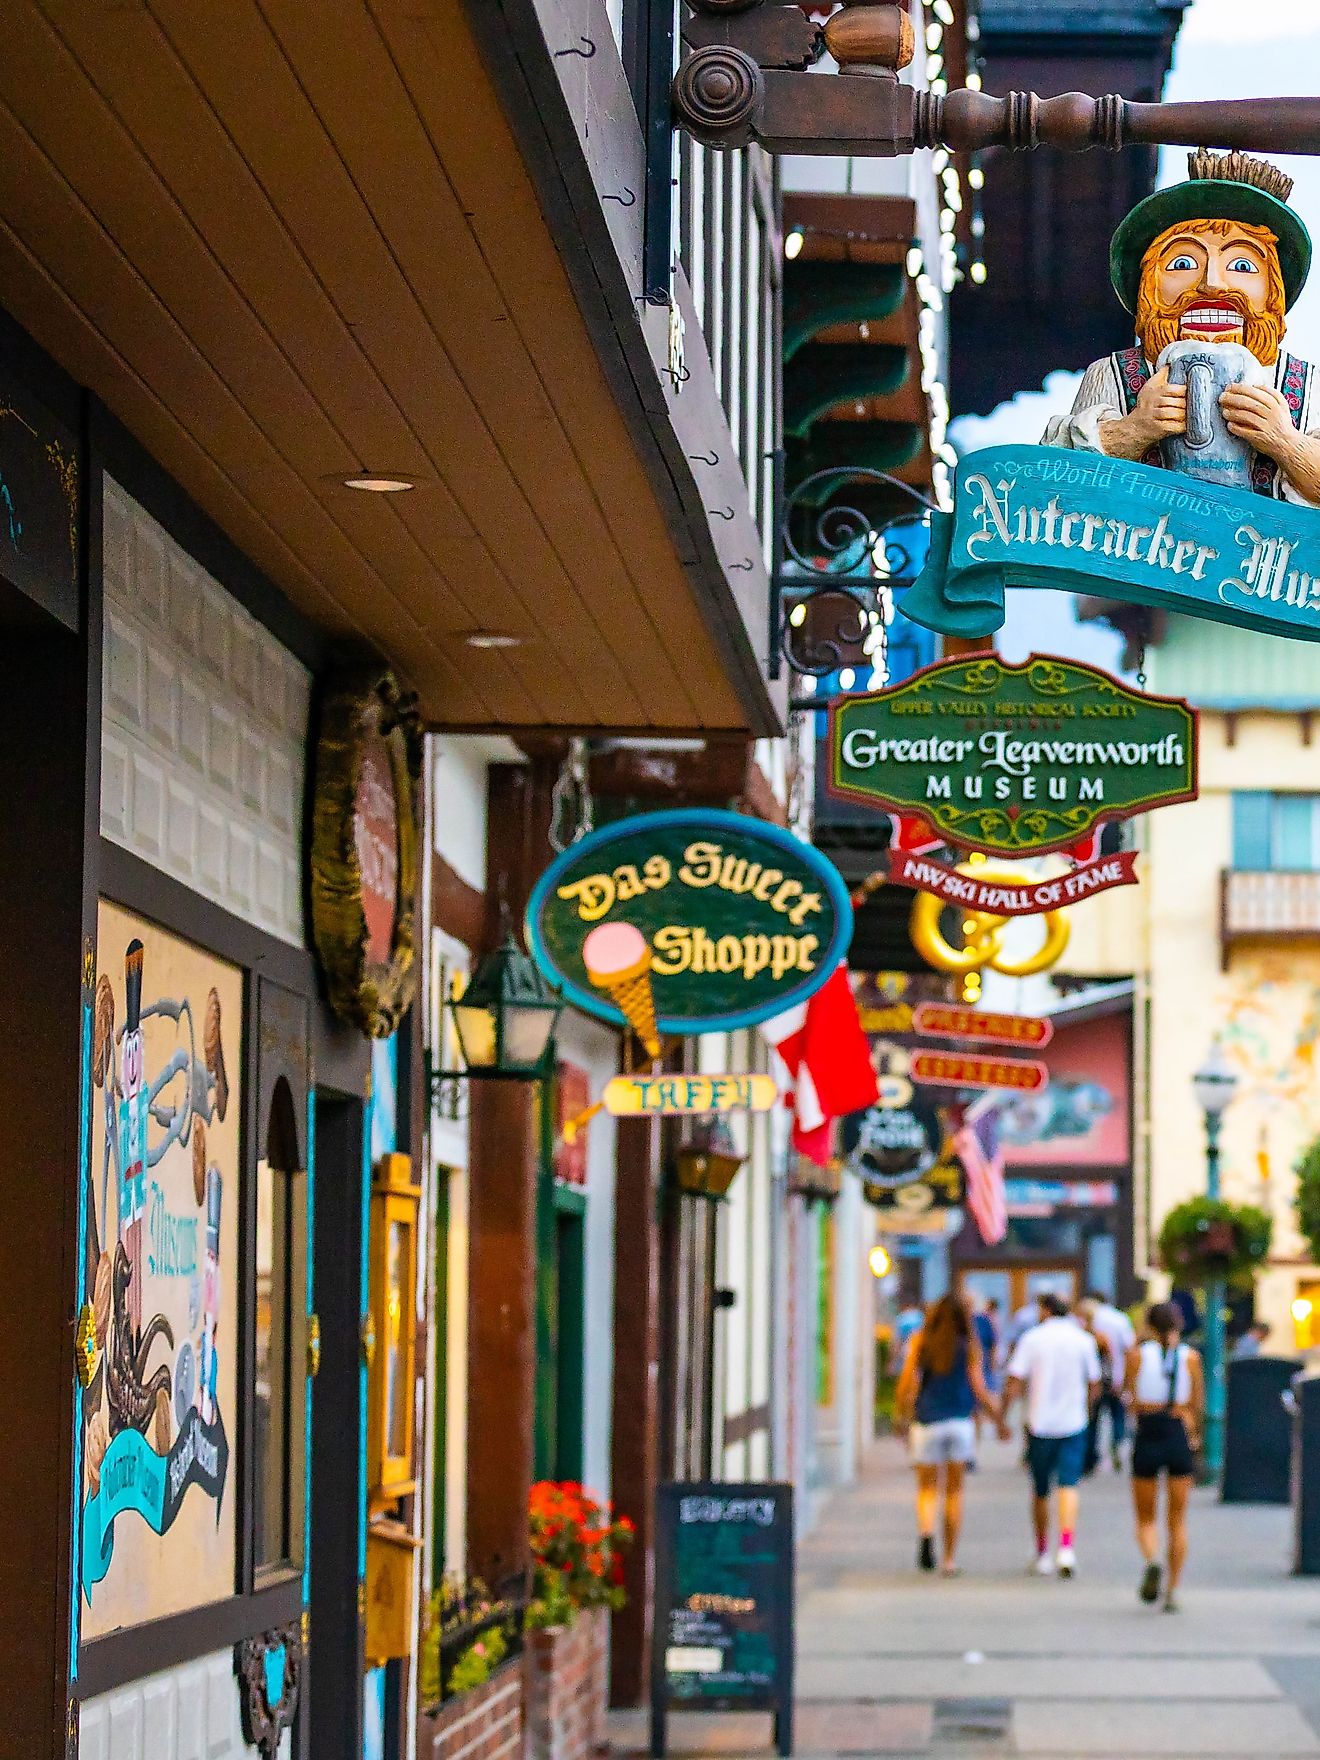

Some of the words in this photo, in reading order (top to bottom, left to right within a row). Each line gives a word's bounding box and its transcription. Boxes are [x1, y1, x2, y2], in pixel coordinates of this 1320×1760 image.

[1024, 459, 1115, 488] World
[1120, 470, 1215, 517] Famous
[965, 473, 1220, 580] Nutcracker
[890, 701, 933, 716] UPPER
[938, 701, 988, 717] VALLEY
[994, 701, 1076, 718] HISTORICAL
[1081, 703, 1137, 718] SOCIETY
[842, 729, 973, 768] Greater
[979, 731, 1184, 776] Leavenworth
[926, 775, 1104, 800] MUSEUM
[557, 855, 672, 921] Das
[679, 842, 823, 925] Sweet
[903, 859, 947, 887] NW
[942, 877, 974, 901] SKI
[978, 887, 1033, 910] HALL
[1034, 883, 1063, 905] OF
[1064, 861, 1123, 897] FAME
[651, 925, 818, 980] Shoppe
[632, 1080, 752, 1110] TAFFY
